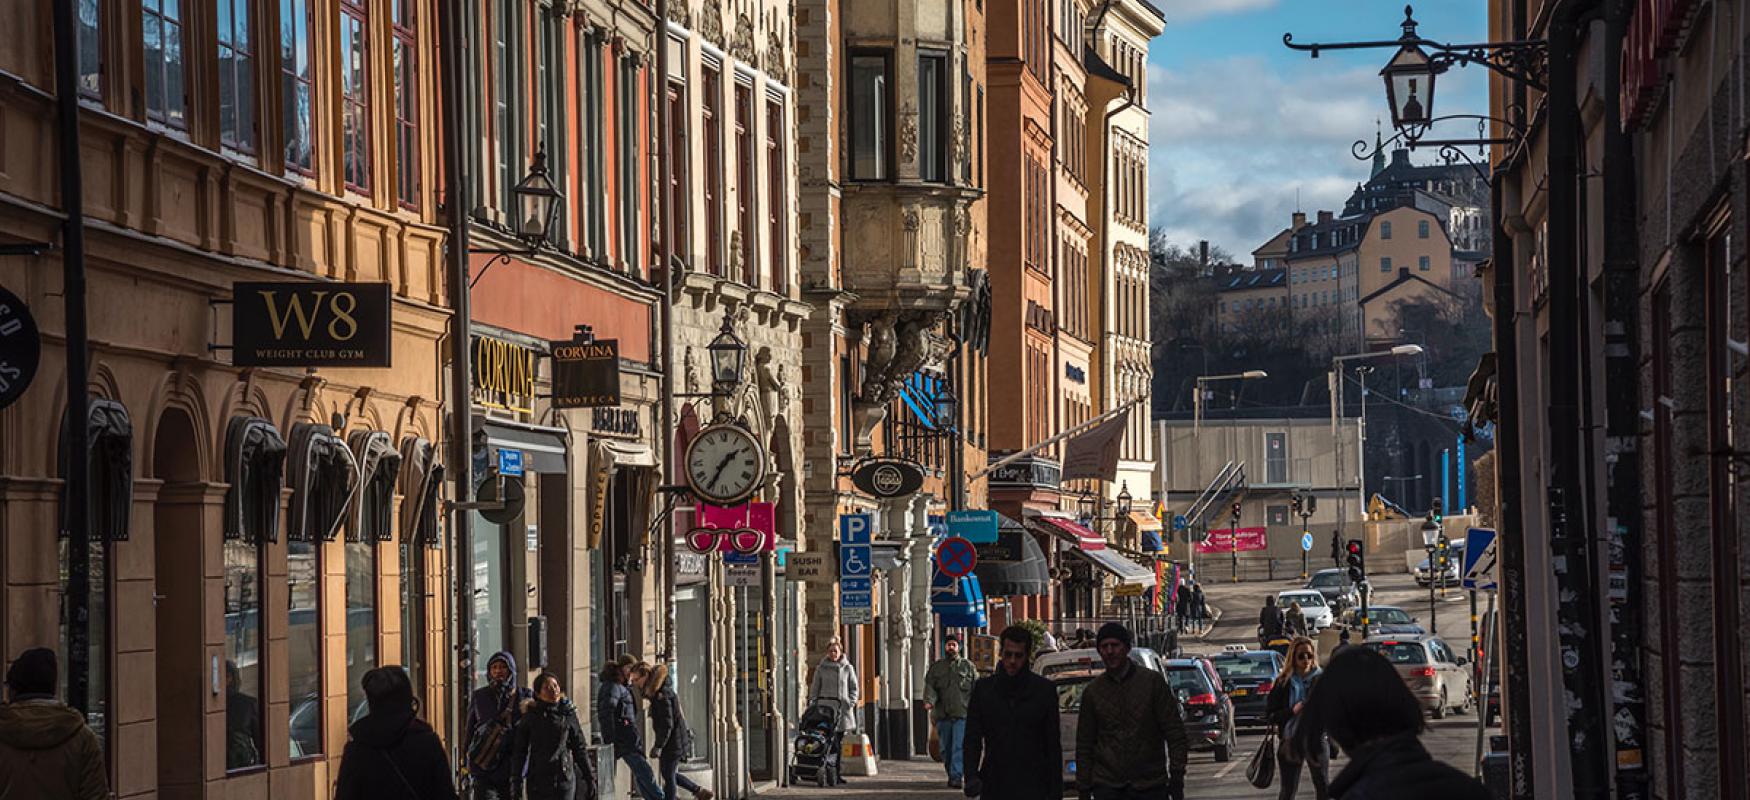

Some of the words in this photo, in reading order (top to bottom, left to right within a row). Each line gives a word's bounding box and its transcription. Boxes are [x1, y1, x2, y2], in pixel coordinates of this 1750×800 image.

[256, 290, 358, 341] W8
[256, 349, 302, 359] WEIGHT
[305, 349, 335, 359] CLUB
[339, 349, 364, 359] GYM
[554, 345, 614, 360] CORVINA
[478, 335, 535, 406] CORVINA
[950, 514, 991, 523] Bankomat
[848, 517, 866, 542] P
[792, 557, 822, 566] SUSHI
[798, 567, 819, 576] BAR
